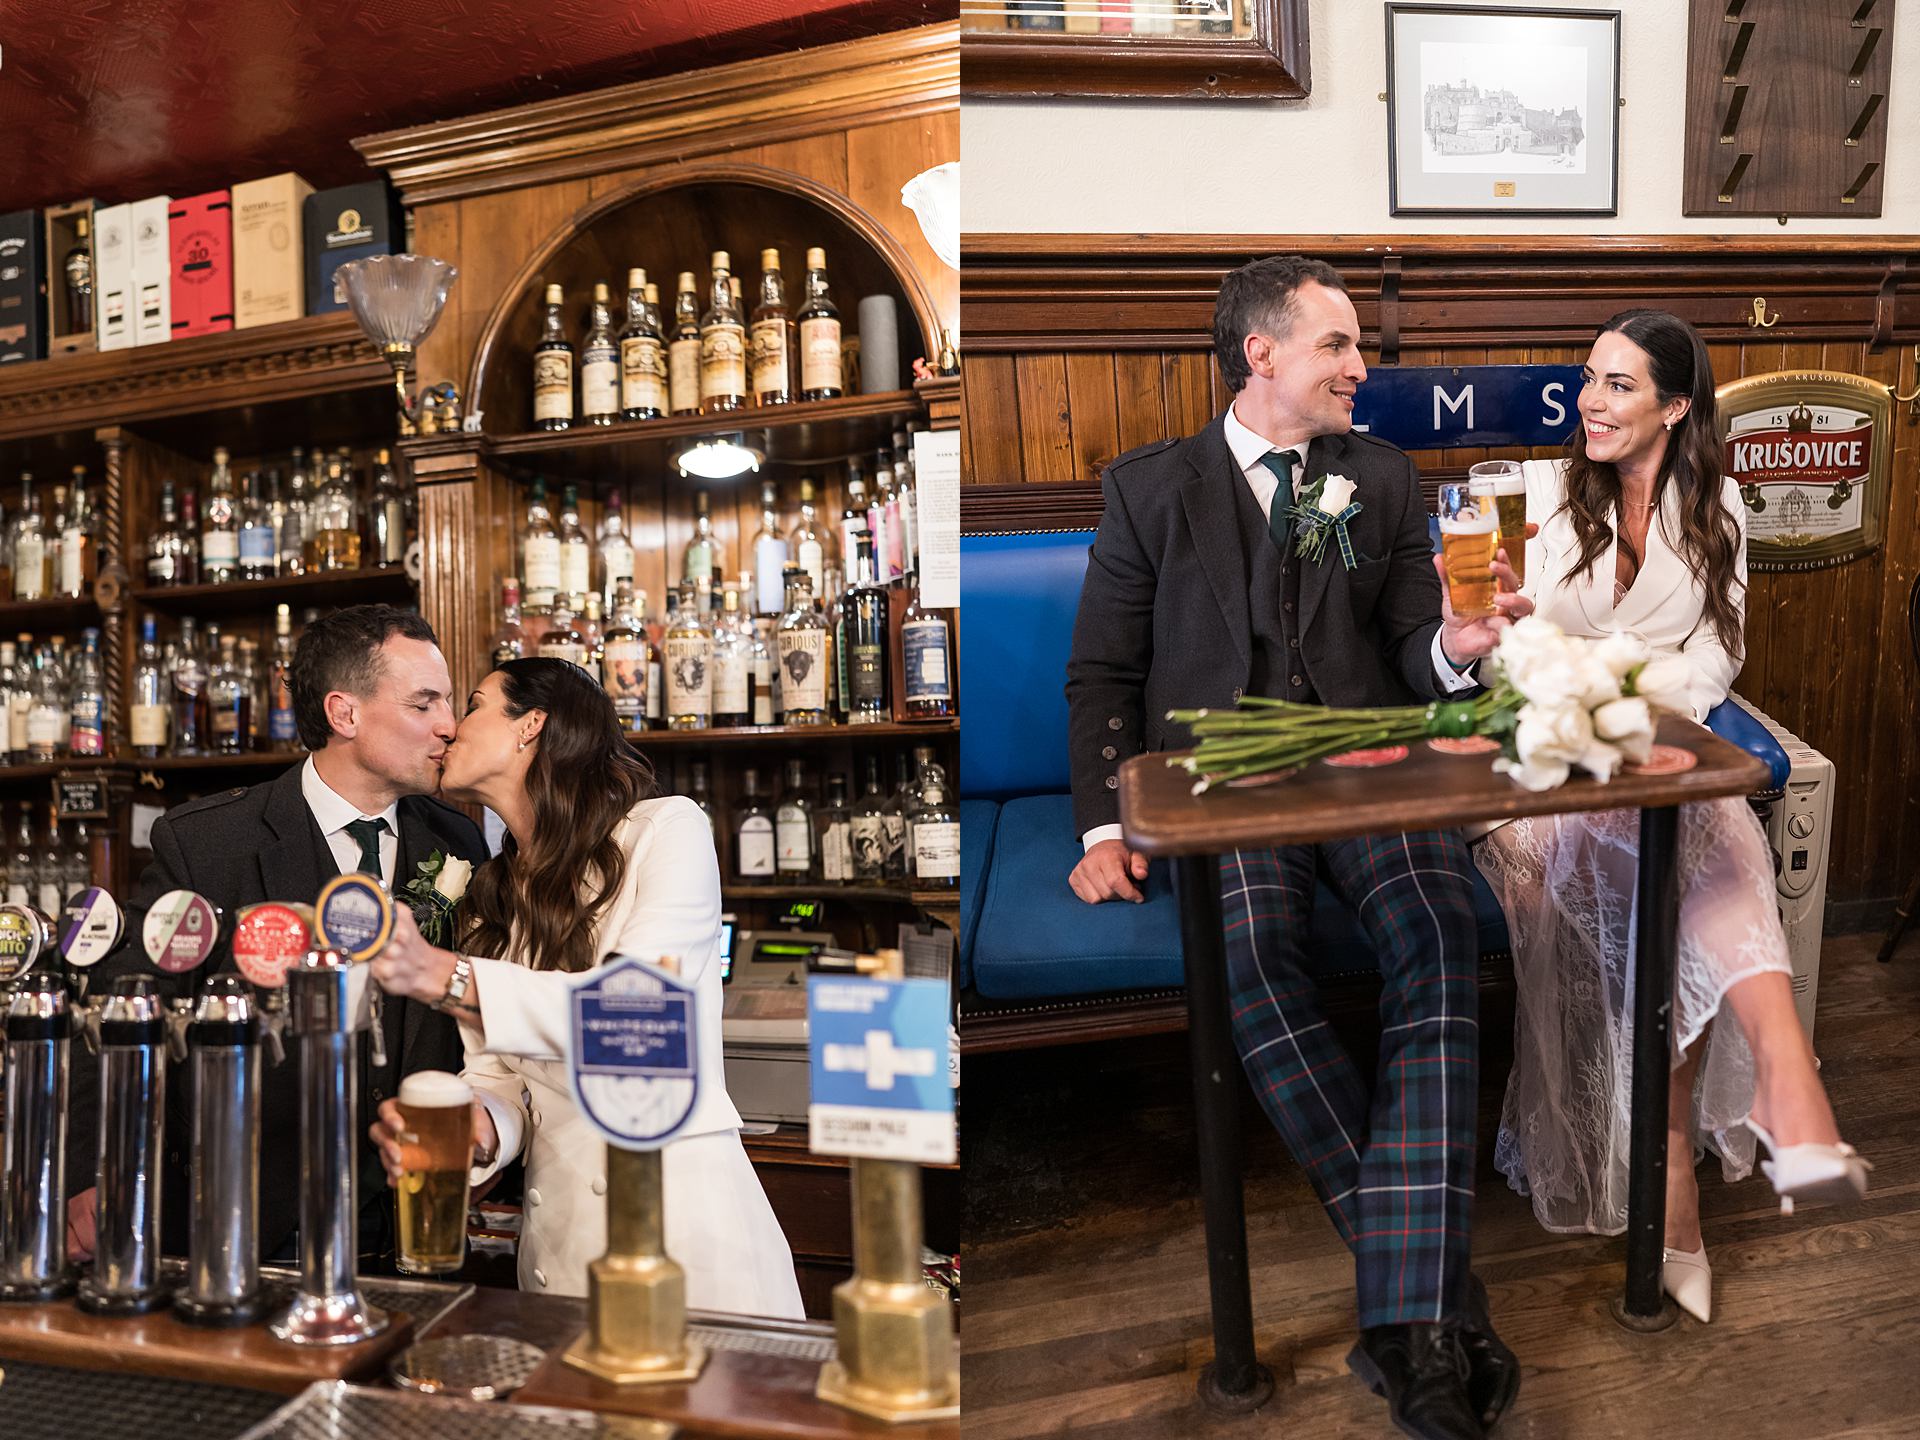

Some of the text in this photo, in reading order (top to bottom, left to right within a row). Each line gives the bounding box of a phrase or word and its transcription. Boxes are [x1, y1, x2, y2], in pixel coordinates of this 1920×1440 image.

[188, 247, 209, 264] 30
[1771, 415, 1829, 425] 15 81
[1733, 437, 1862, 473] KRUŠOVICE
[1749, 552, 1855, 571] ORTED CZECH BEER
